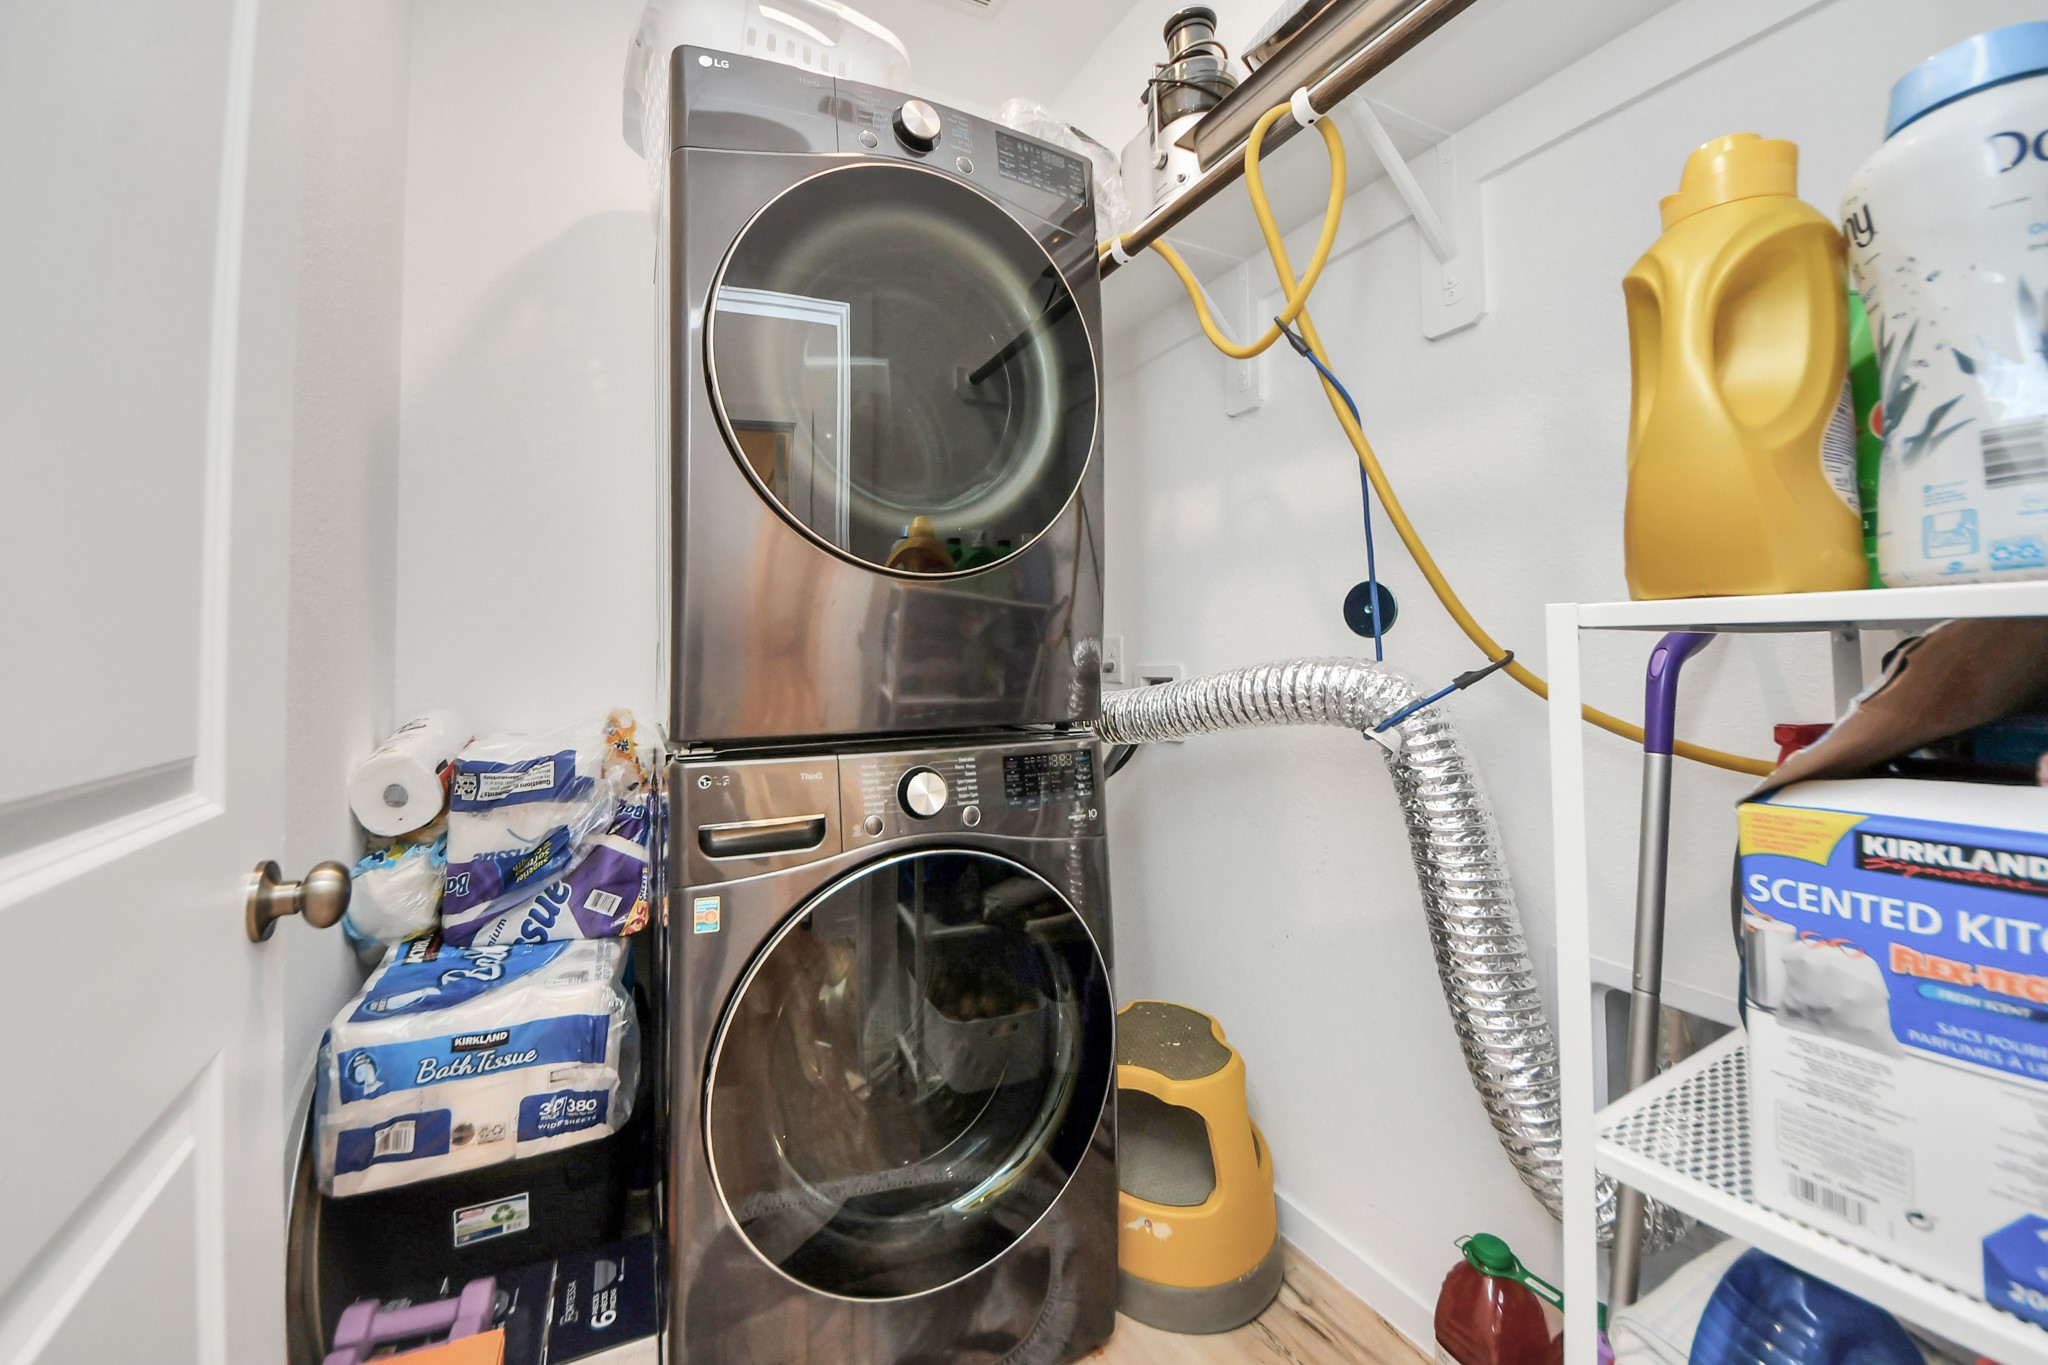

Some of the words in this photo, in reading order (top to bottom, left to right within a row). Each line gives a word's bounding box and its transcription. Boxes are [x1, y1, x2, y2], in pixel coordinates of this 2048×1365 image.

[714, 58, 729, 69] LG
[520, 779, 551, 788] Questions
[800, 771, 823, 781] ThinQ
[1088, 808, 1098, 818] 10
[1861, 833, 2048, 881] KIRKLAND
[514, 880, 571, 944] sue
[1749, 873, 1943, 936] SCENTED
[1956, 909, 2048, 956] KIT
[1984, 999, 2032, 1018] SCENT
[454, 1031, 508, 1046] KIRKLAND
[1936, 1021, 1982, 1044] SACS
[415, 1054, 477, 1084] Bath
[476, 1049, 538, 1073] Tissue
[567, 1098, 597, 1112] 380
[2006, 1279, 2048, 1313] 20
[591, 1310, 617, 1328] 6
